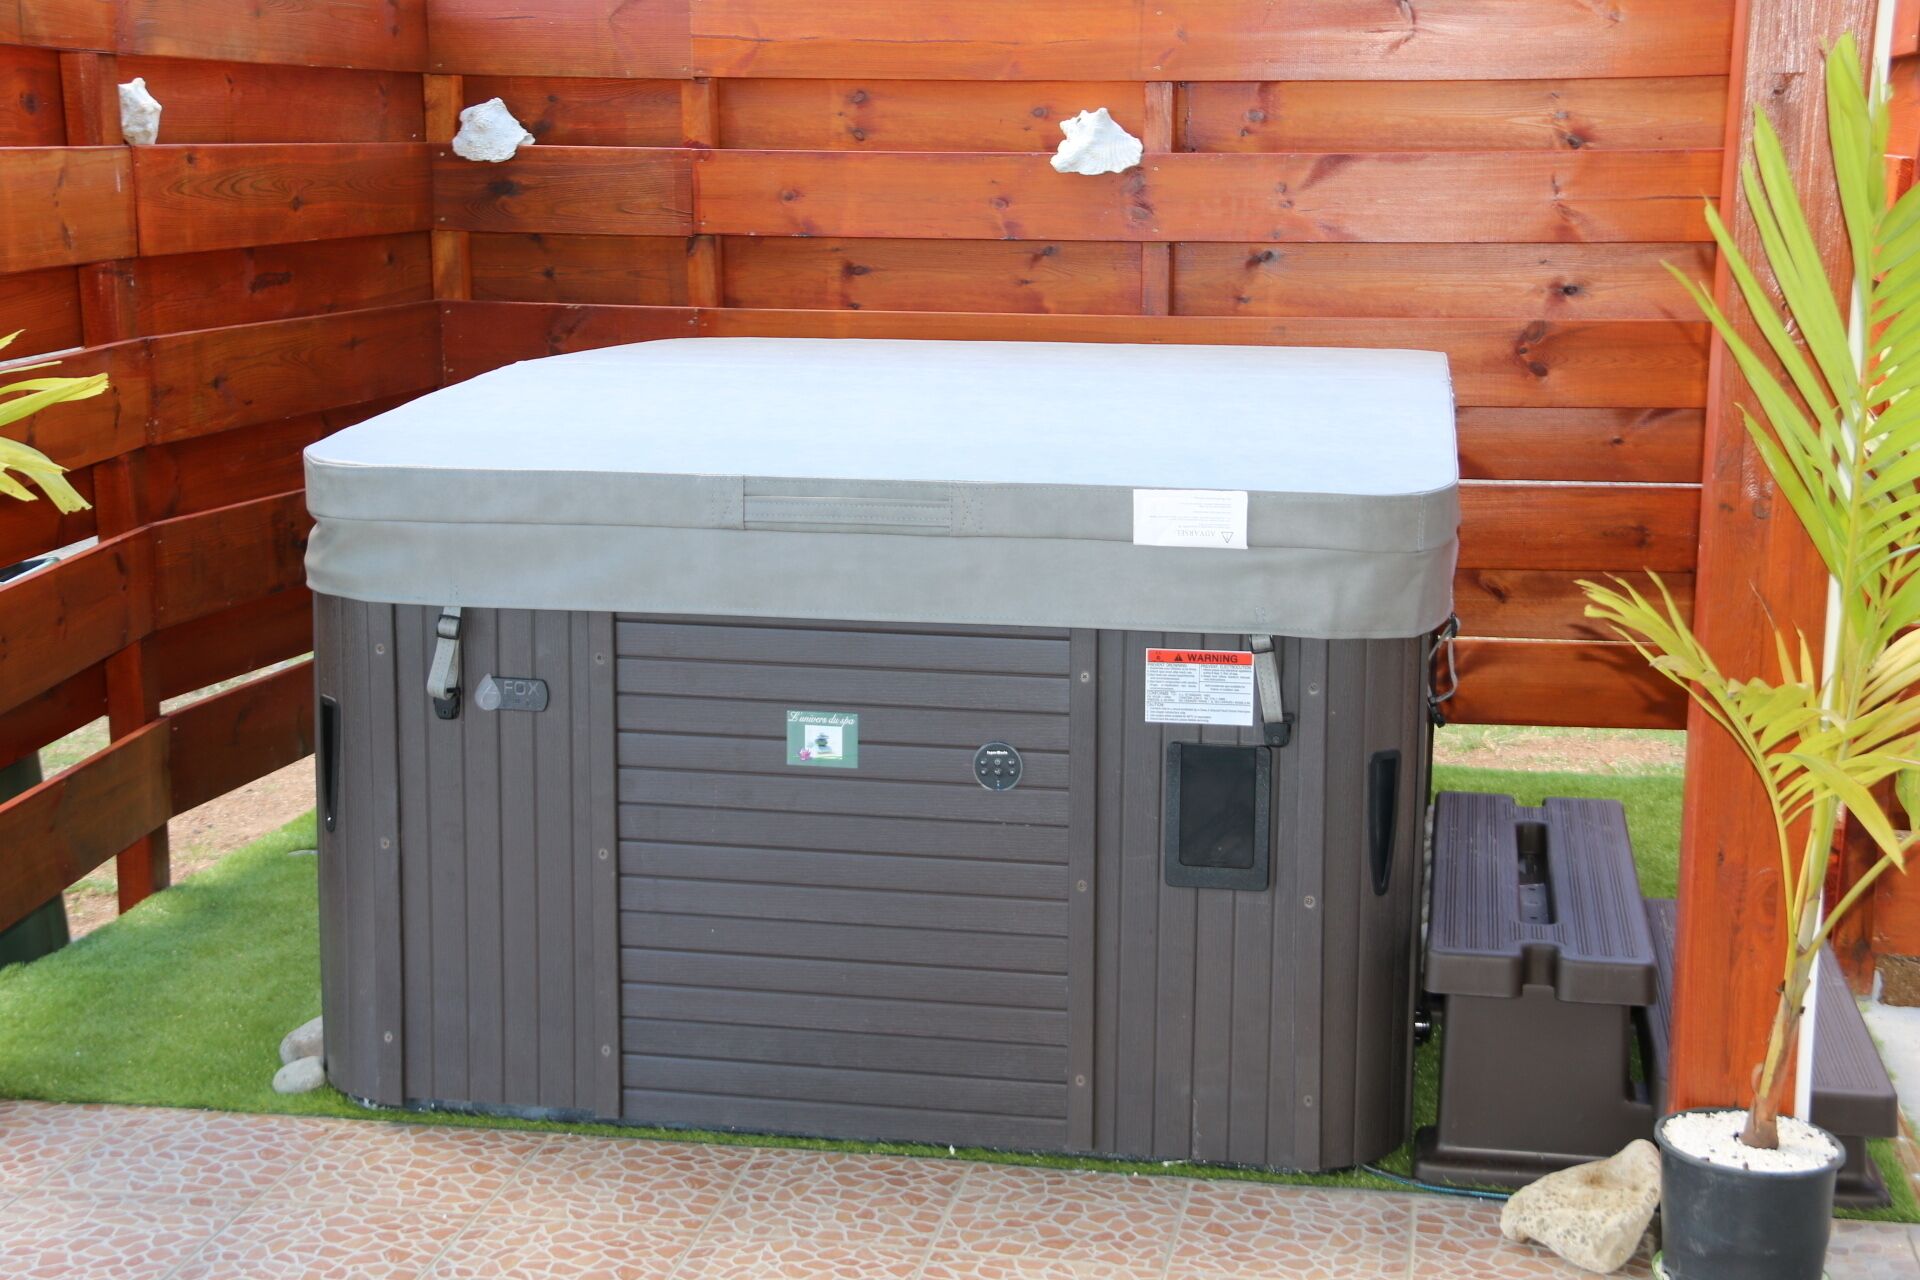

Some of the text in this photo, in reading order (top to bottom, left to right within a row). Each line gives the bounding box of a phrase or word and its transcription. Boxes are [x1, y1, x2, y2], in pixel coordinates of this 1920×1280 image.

[1176, 529, 1216, 537] ADVARSEL
[1187, 653, 1238, 663] WARNING
[503, 680, 540, 696] FOX
[788, 711, 855, 728] L'univers du spa
